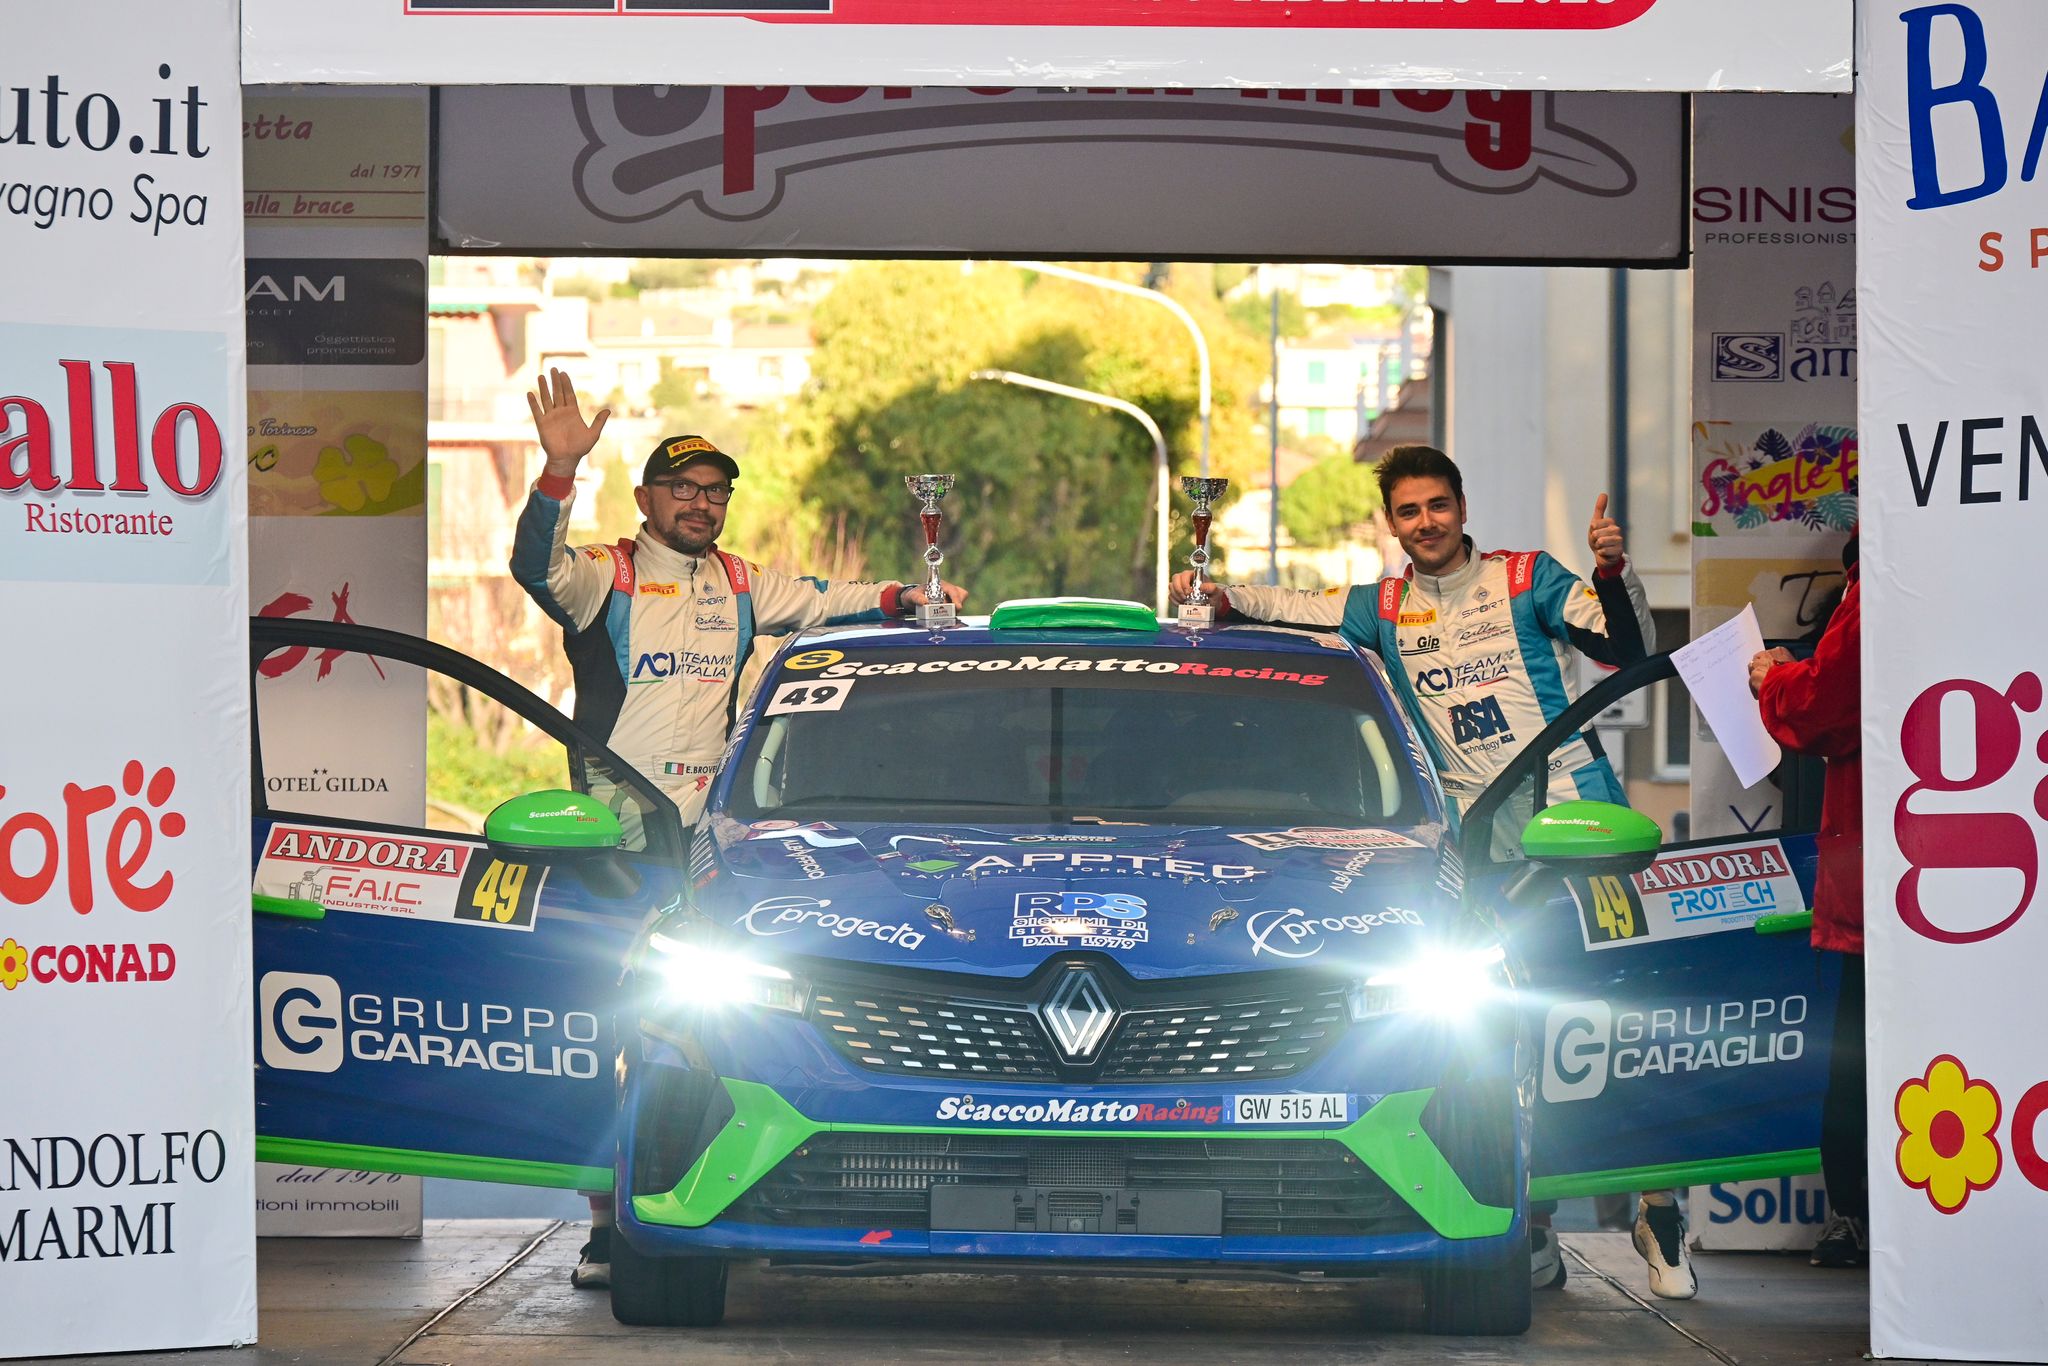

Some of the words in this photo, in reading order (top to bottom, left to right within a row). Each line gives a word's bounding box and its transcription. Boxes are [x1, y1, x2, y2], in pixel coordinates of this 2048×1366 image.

[351, 164, 375, 178] dal
[383, 164, 421, 178] 1971
[130, 173, 207, 236] Spa
[293, 195, 355, 214] brace
[1692, 187, 1856, 223] SINIS
[24, 503, 173, 536] Ristorante
[1400, 611, 1434, 625] PIRELLI
[1461, 599, 1506, 619] SPORT
[1417, 635, 1440, 649] Gip
[1455, 654, 1501, 676] TEAM
[1455, 664, 1509, 687] ITALIA
[780, 686, 839, 706] 49
[265, 777, 321, 793] OTEL
[326, 777, 389, 793] GILDA
[0, 781, 174, 915] ore
[271, 833, 457, 873] ANDORA
[1640, 846, 1785, 891] ANDORA
[472, 858, 529, 923] 49
[1014, 891, 1148, 919] RPS
[322, 899, 388, 911] INDUSTRY
[391, 906, 415, 914] SRL
[1588, 875, 1634, 938] 49
[771, 906, 926, 950] progecta
[1015, 927, 1143, 939] SICEZZA
[1121, 920, 1147, 930] DI
[1281, 906, 1425, 945] progecta
[1023, 936, 1068, 947] DAL
[1081, 937, 1136, 950] 1979
[31, 943, 176, 983] CONAD
[349, 994, 598, 1043] GRUPPO
[1616, 995, 1807, 1043] GRUPPO
[350, 1030, 598, 1079] CARAGLIO
[1613, 1030, 1804, 1079] CARAGLIO
[1239, 1098, 1272, 1120] GW
[1279, 1097, 1312, 1120] 515
[1319, 1096, 1344, 1119] AL
[0, 1129, 225, 1191] NDOLFO
[276, 1167, 333, 1184] dal
[306, 1199, 399, 1212] immobili
[1709, 1176, 1826, 1225] Solu
